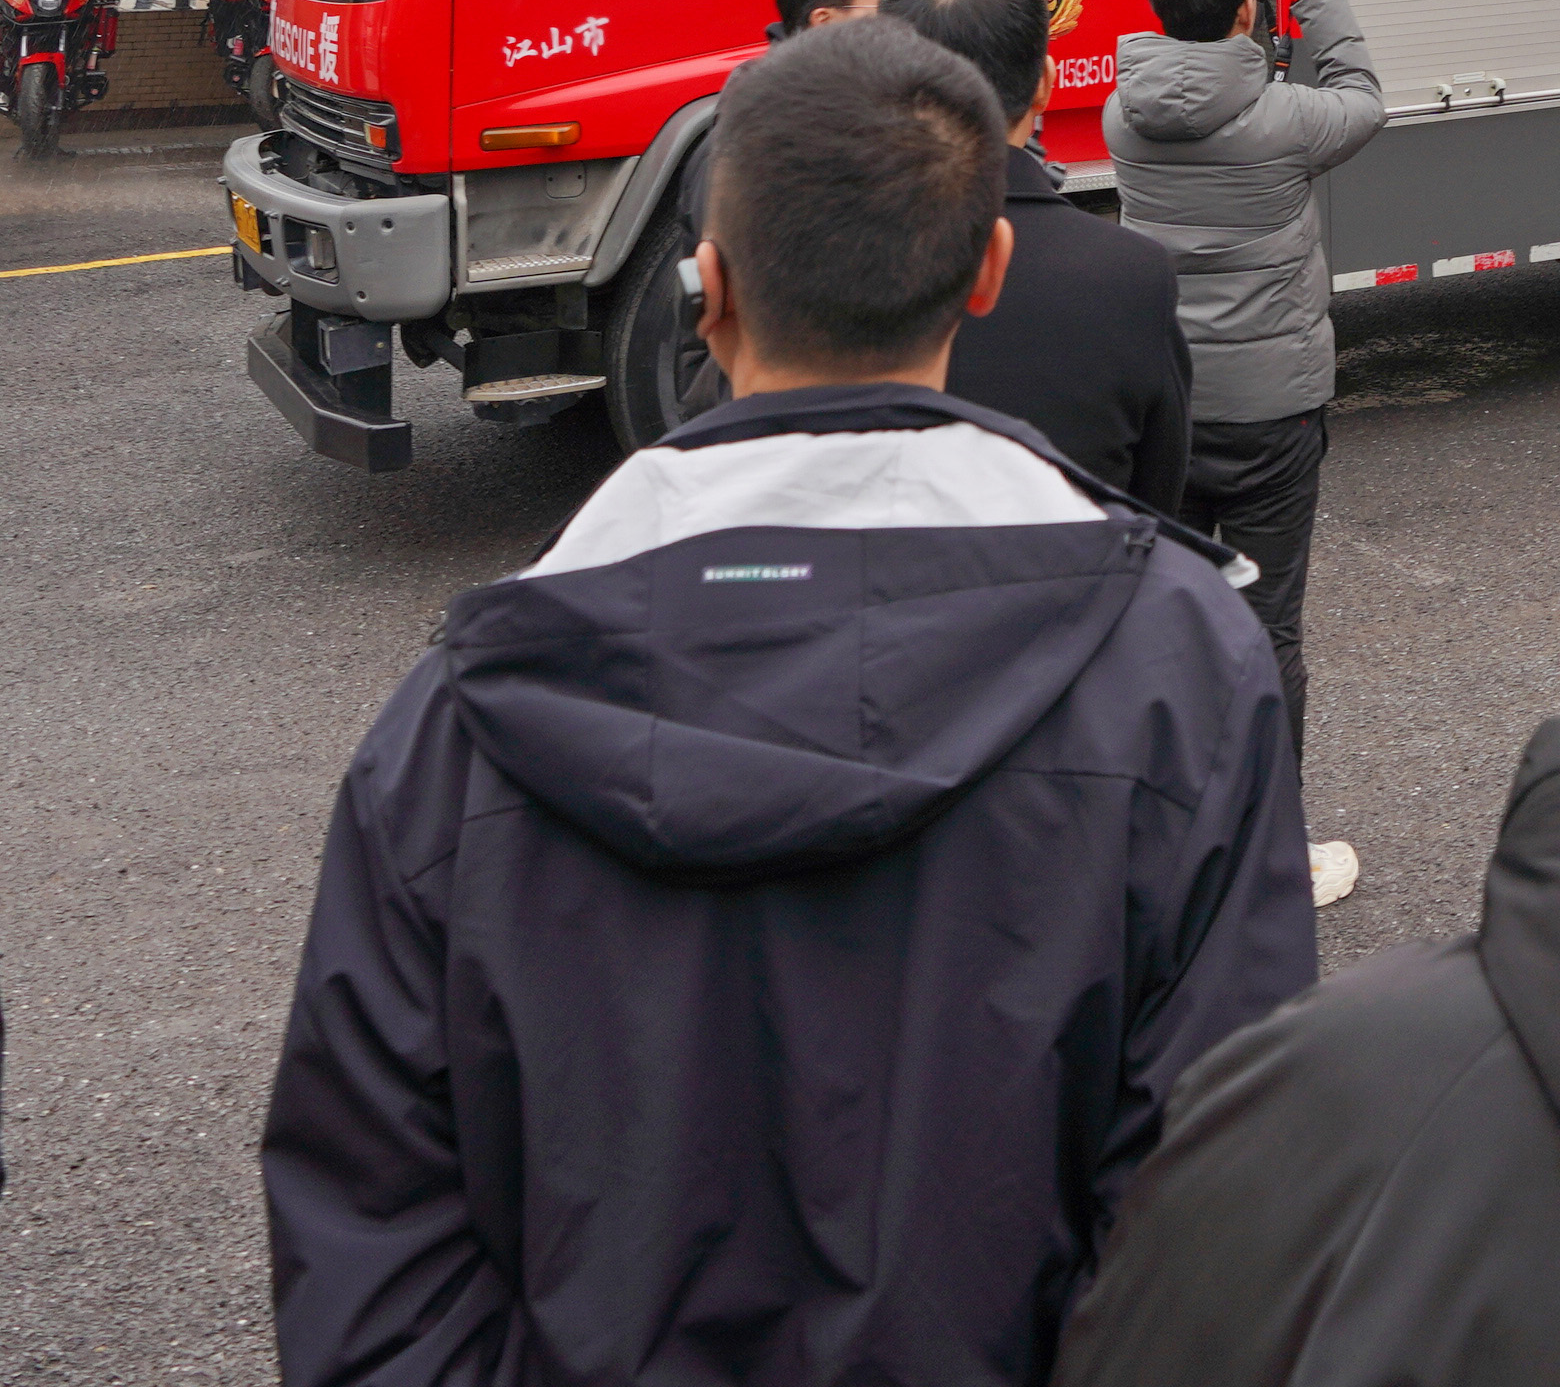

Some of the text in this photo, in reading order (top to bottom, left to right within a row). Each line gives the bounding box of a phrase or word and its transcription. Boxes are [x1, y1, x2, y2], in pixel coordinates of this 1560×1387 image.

[275, 17, 316, 72] RESCUE
[318, 12, 340, 85] 援
[502, 16, 610, 67] 江山市
